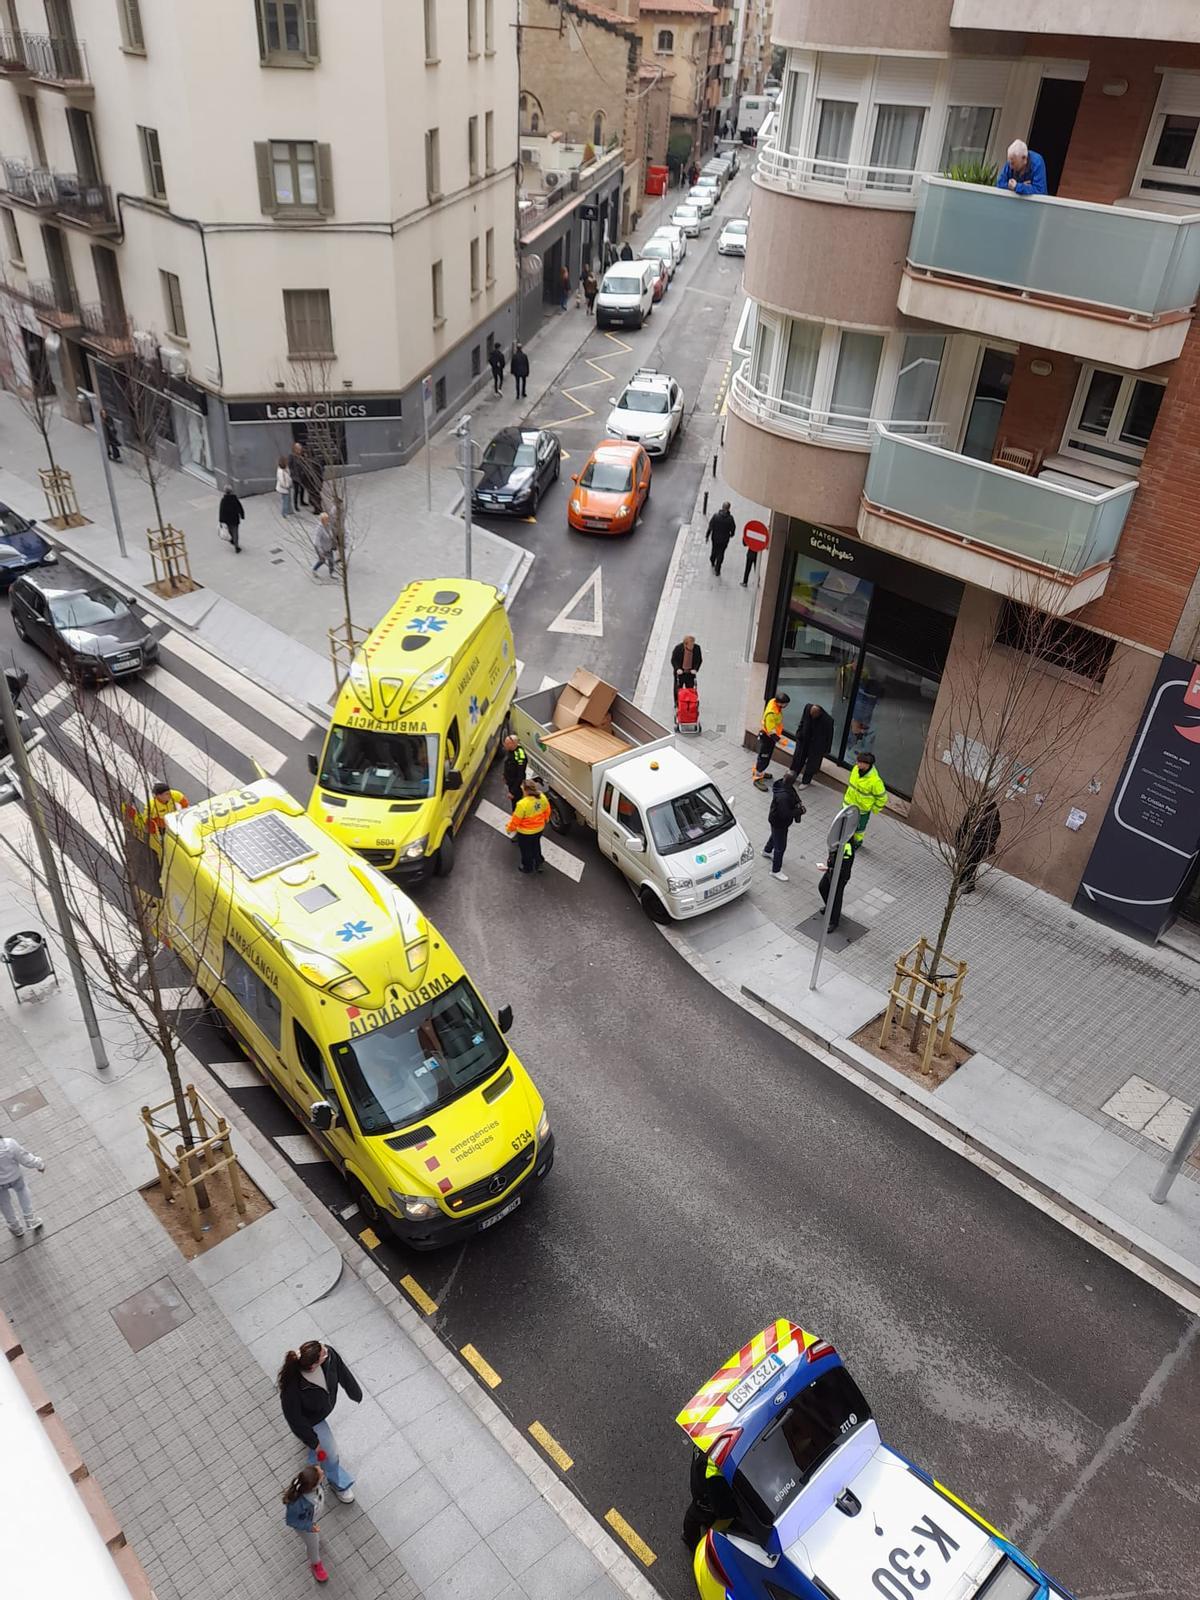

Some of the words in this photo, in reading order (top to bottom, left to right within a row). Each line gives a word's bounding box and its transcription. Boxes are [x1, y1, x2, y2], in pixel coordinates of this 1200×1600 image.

[415, 605, 463, 616] 6604
[376, 837, 396, 847] 6604
[450, 1119, 500, 1155] emergències
[511, 1129, 533, 1152] 6734
[754, 1358, 777, 1386] 7252
[732, 1383, 752, 1405] MSB
[839, 1420, 853, 1434] 112
[871, 1514, 961, 1600] K-30
